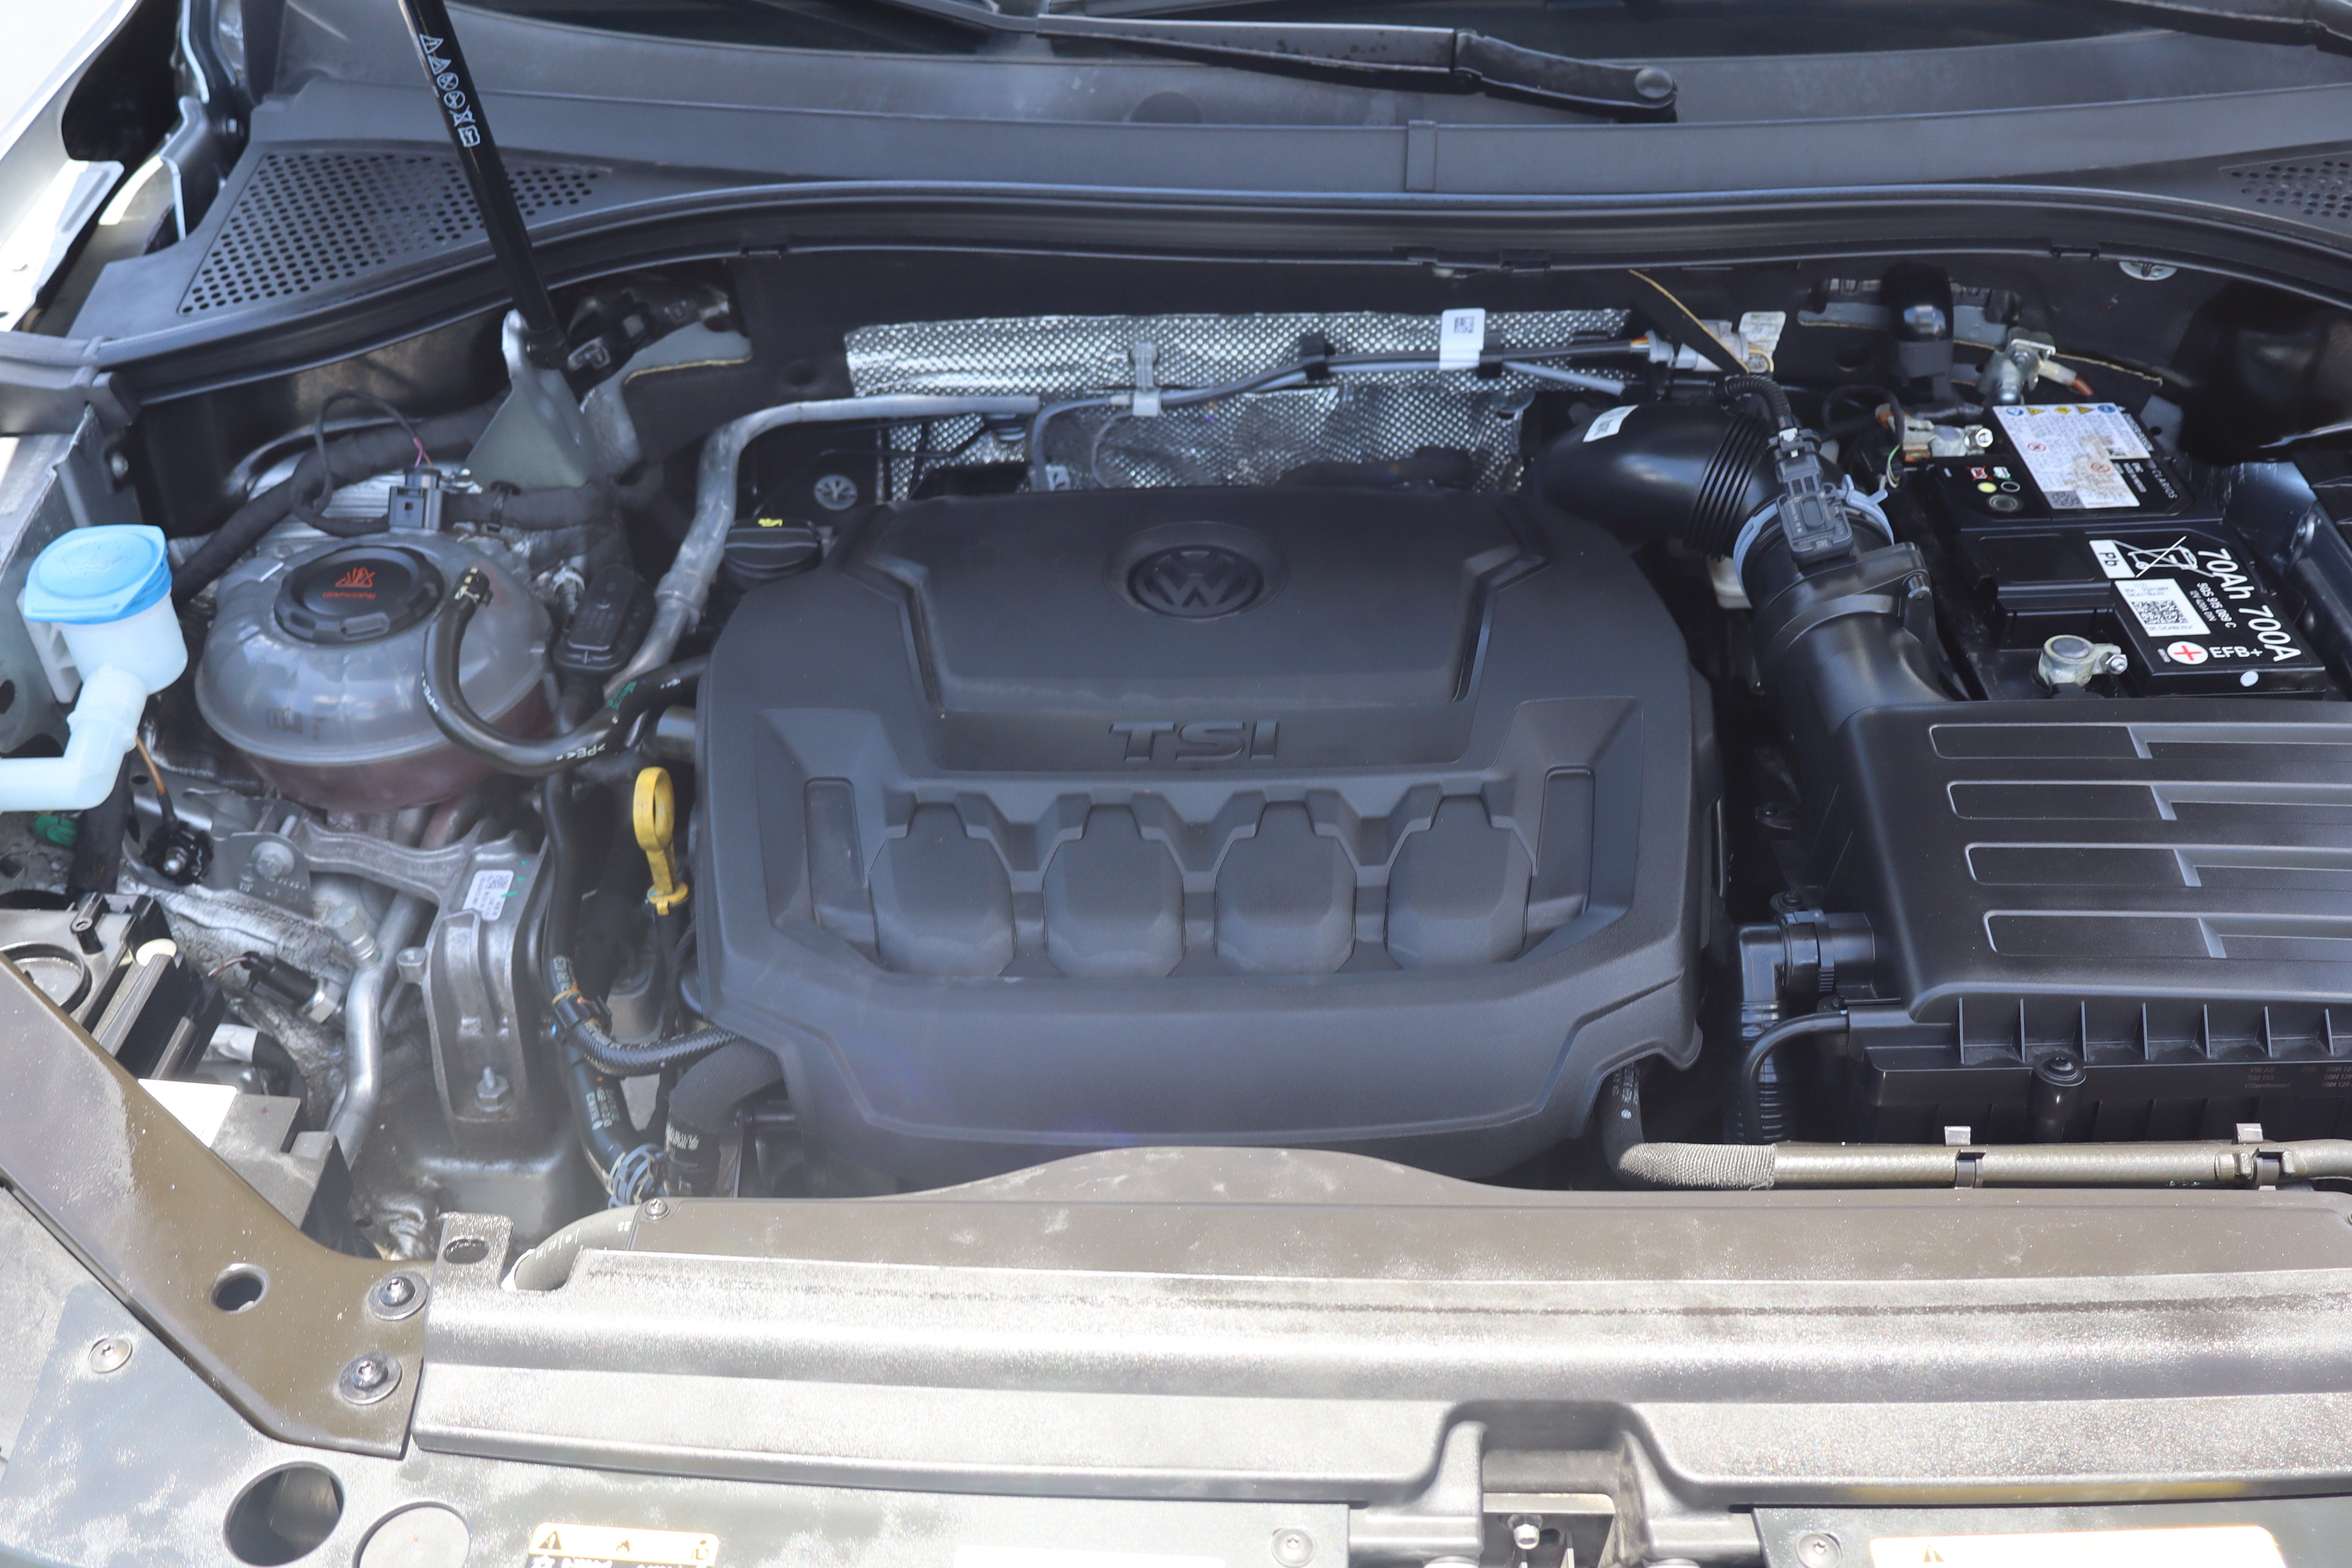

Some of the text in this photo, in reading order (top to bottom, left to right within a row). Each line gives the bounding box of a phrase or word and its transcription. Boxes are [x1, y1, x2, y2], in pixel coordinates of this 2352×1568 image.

[2098, 552, 2118, 567] Pb
[1129, 545, 1264, 618] VW
[2197, 548, 2302, 662] 70Ah 700A
[2208, 646, 2263, 658] EFB+
[1109, 720, 1281, 763] TSI
